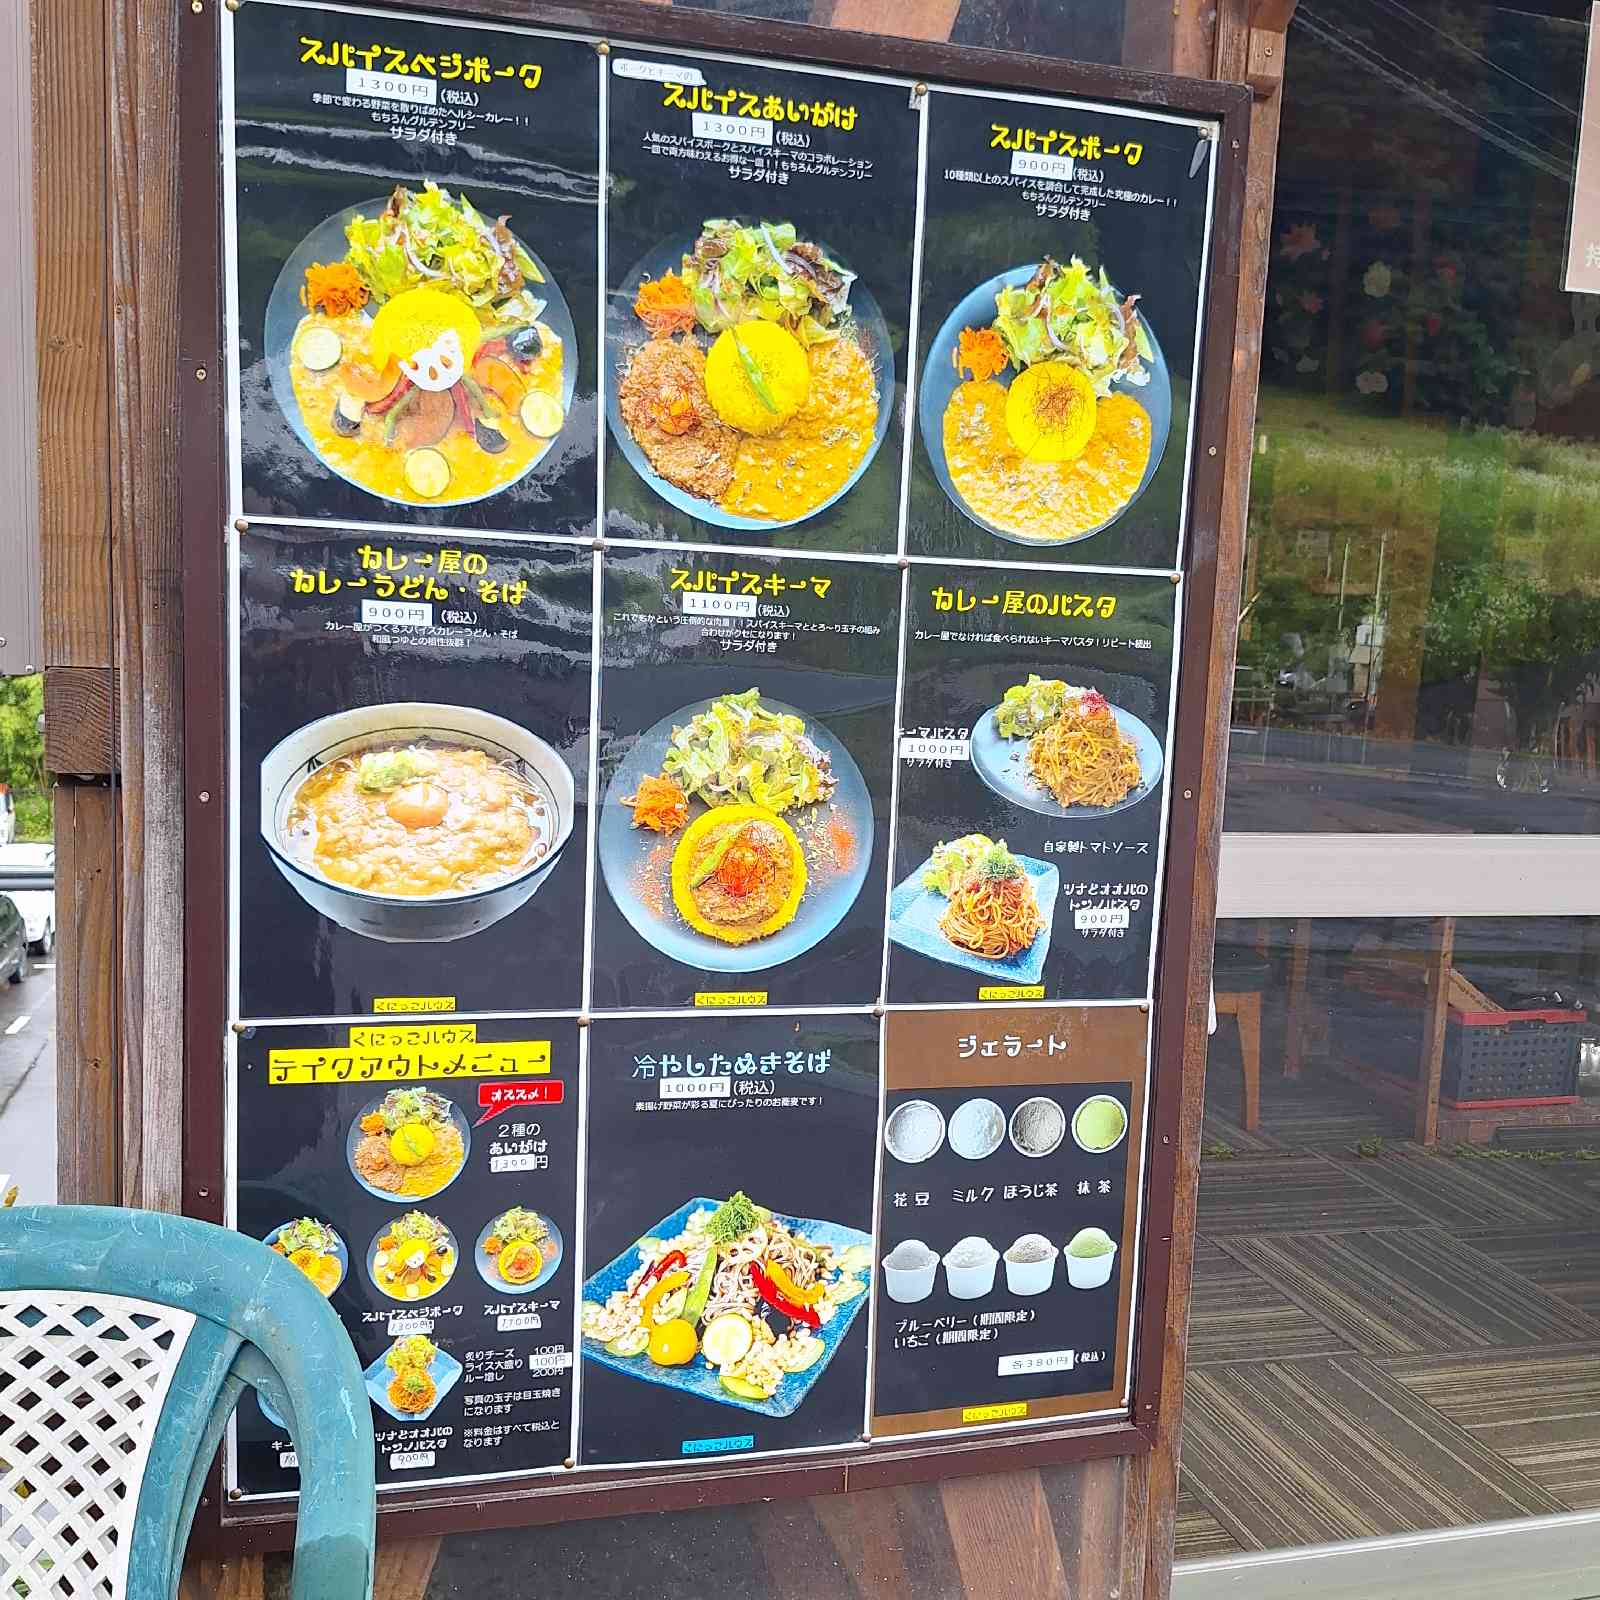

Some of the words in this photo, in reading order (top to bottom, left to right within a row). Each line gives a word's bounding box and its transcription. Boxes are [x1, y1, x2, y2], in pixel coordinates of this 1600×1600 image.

[299, 35, 544, 90] スパイスベジポーク
[356, 75, 430, 99] 1300円
[440, 87, 480, 107] (税込)
[662, 81, 858, 132] スパイスあいがけ
[370, 111, 476, 131] もちろんグルテンフリー
[389, 125, 458, 146] サラダ付き
[702, 120, 766, 139] 1300円
[775, 129, 811, 148] (税込)
[990, 122, 1144, 167] スパイスポーク
[727, 164, 790, 186] サラダ付き
[1017, 158, 1066, 176] 900円
[1072, 167, 1105, 183] (税込)
[1021, 190, 1107, 208] もちろんグルテンフリー
[1035, 203, 1092, 222] サラダ付き
[357, 544, 488, 576] カレー屋の
[289, 568, 529, 605] カレーうどん・そば
[670, 567, 832, 599] スパイスキーマ
[688, 597, 751, 614] 1100円
[757, 603, 791, 618] (税込)
[930, 586, 1118, 620] カレー屋のパスタ
[368, 606, 426, 622] 900円
[440, 609, 479, 626] (税込)
[719, 639, 778, 653] サラダ付き
[907, 744, 964, 755] 1000円
[1043, 840, 1150, 854] 自家製トマトソース
[1080, 913, 1124, 925] 900円
[352, 1029, 476, 1047] くにっこハウス
[957, 1034, 1068, 1058] ジェラート
[271, 1053, 548, 1083] テイクアウトメニュー
[631, 1049, 832, 1079] 冷やしたぬきそば
[664, 1081, 726, 1094] 1000円
[732, 1079, 776, 1096] (税込)
[498, 1122, 541, 1138] 2種の
[489, 1139, 548, 1155] あいがけ
[952, 1186, 995, 1203] ミルク
[1003, 1182, 1060, 1200] ほうじ茶
[483, 1300, 561, 1316] スパイスキーマ
[533, 1344, 565, 1355] 100円
[464, 1358, 524, 1374] ライス大盛り
[464, 1371, 505, 1384] ルー増し
[532, 1367, 565, 1378] 200円
[463, 1387, 561, 1406] 写真の玉子は目玉焼き
[463, 1403, 513, 1417] になります
[463, 1436, 503, 1448] なります
